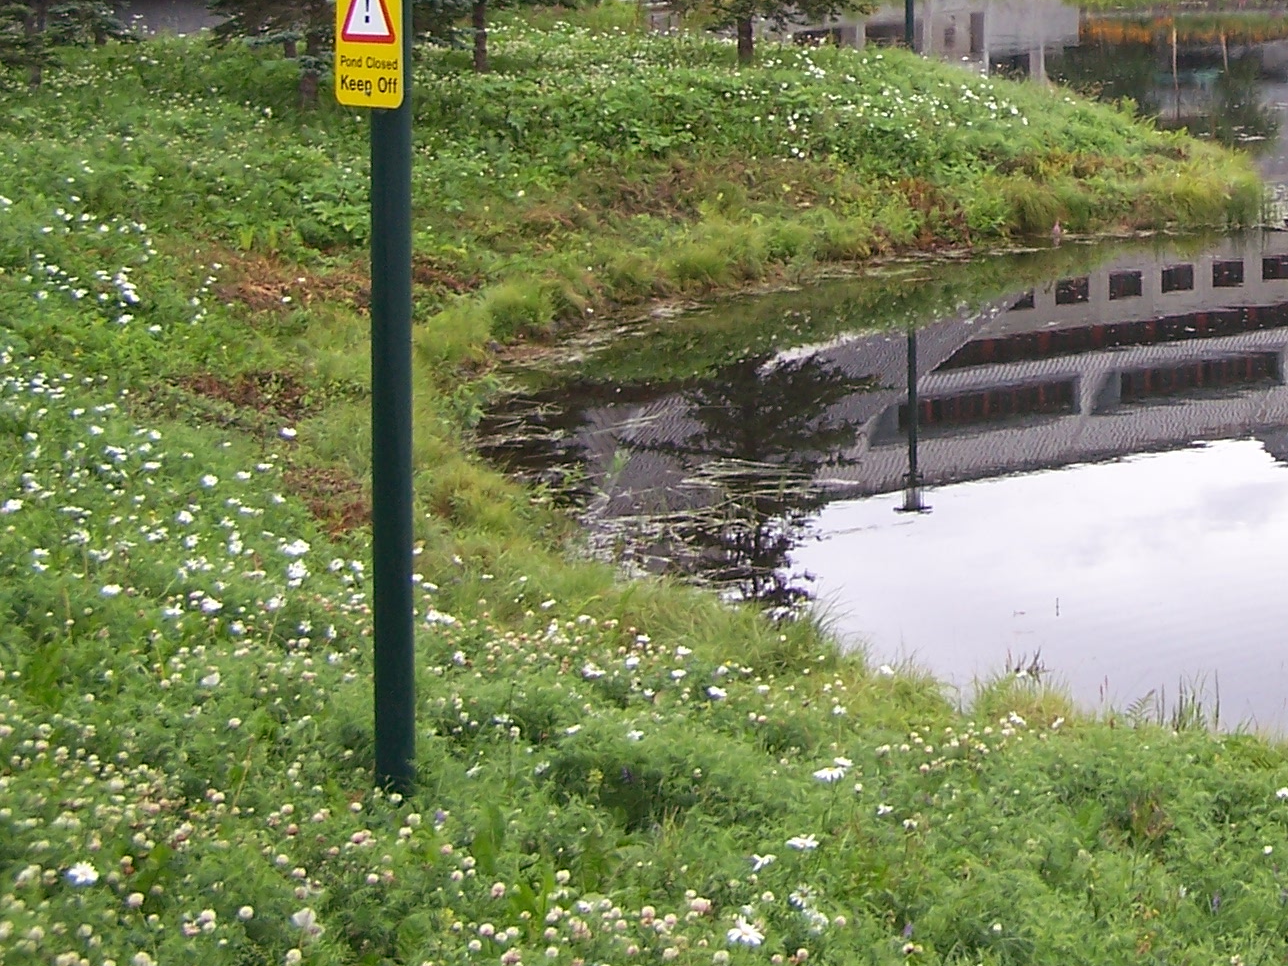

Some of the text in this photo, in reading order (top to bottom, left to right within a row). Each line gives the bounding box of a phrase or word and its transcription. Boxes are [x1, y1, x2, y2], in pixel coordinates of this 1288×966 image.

[340, 55, 398, 70] Pond Closed
[340, 75, 398, 96] Keep Off
